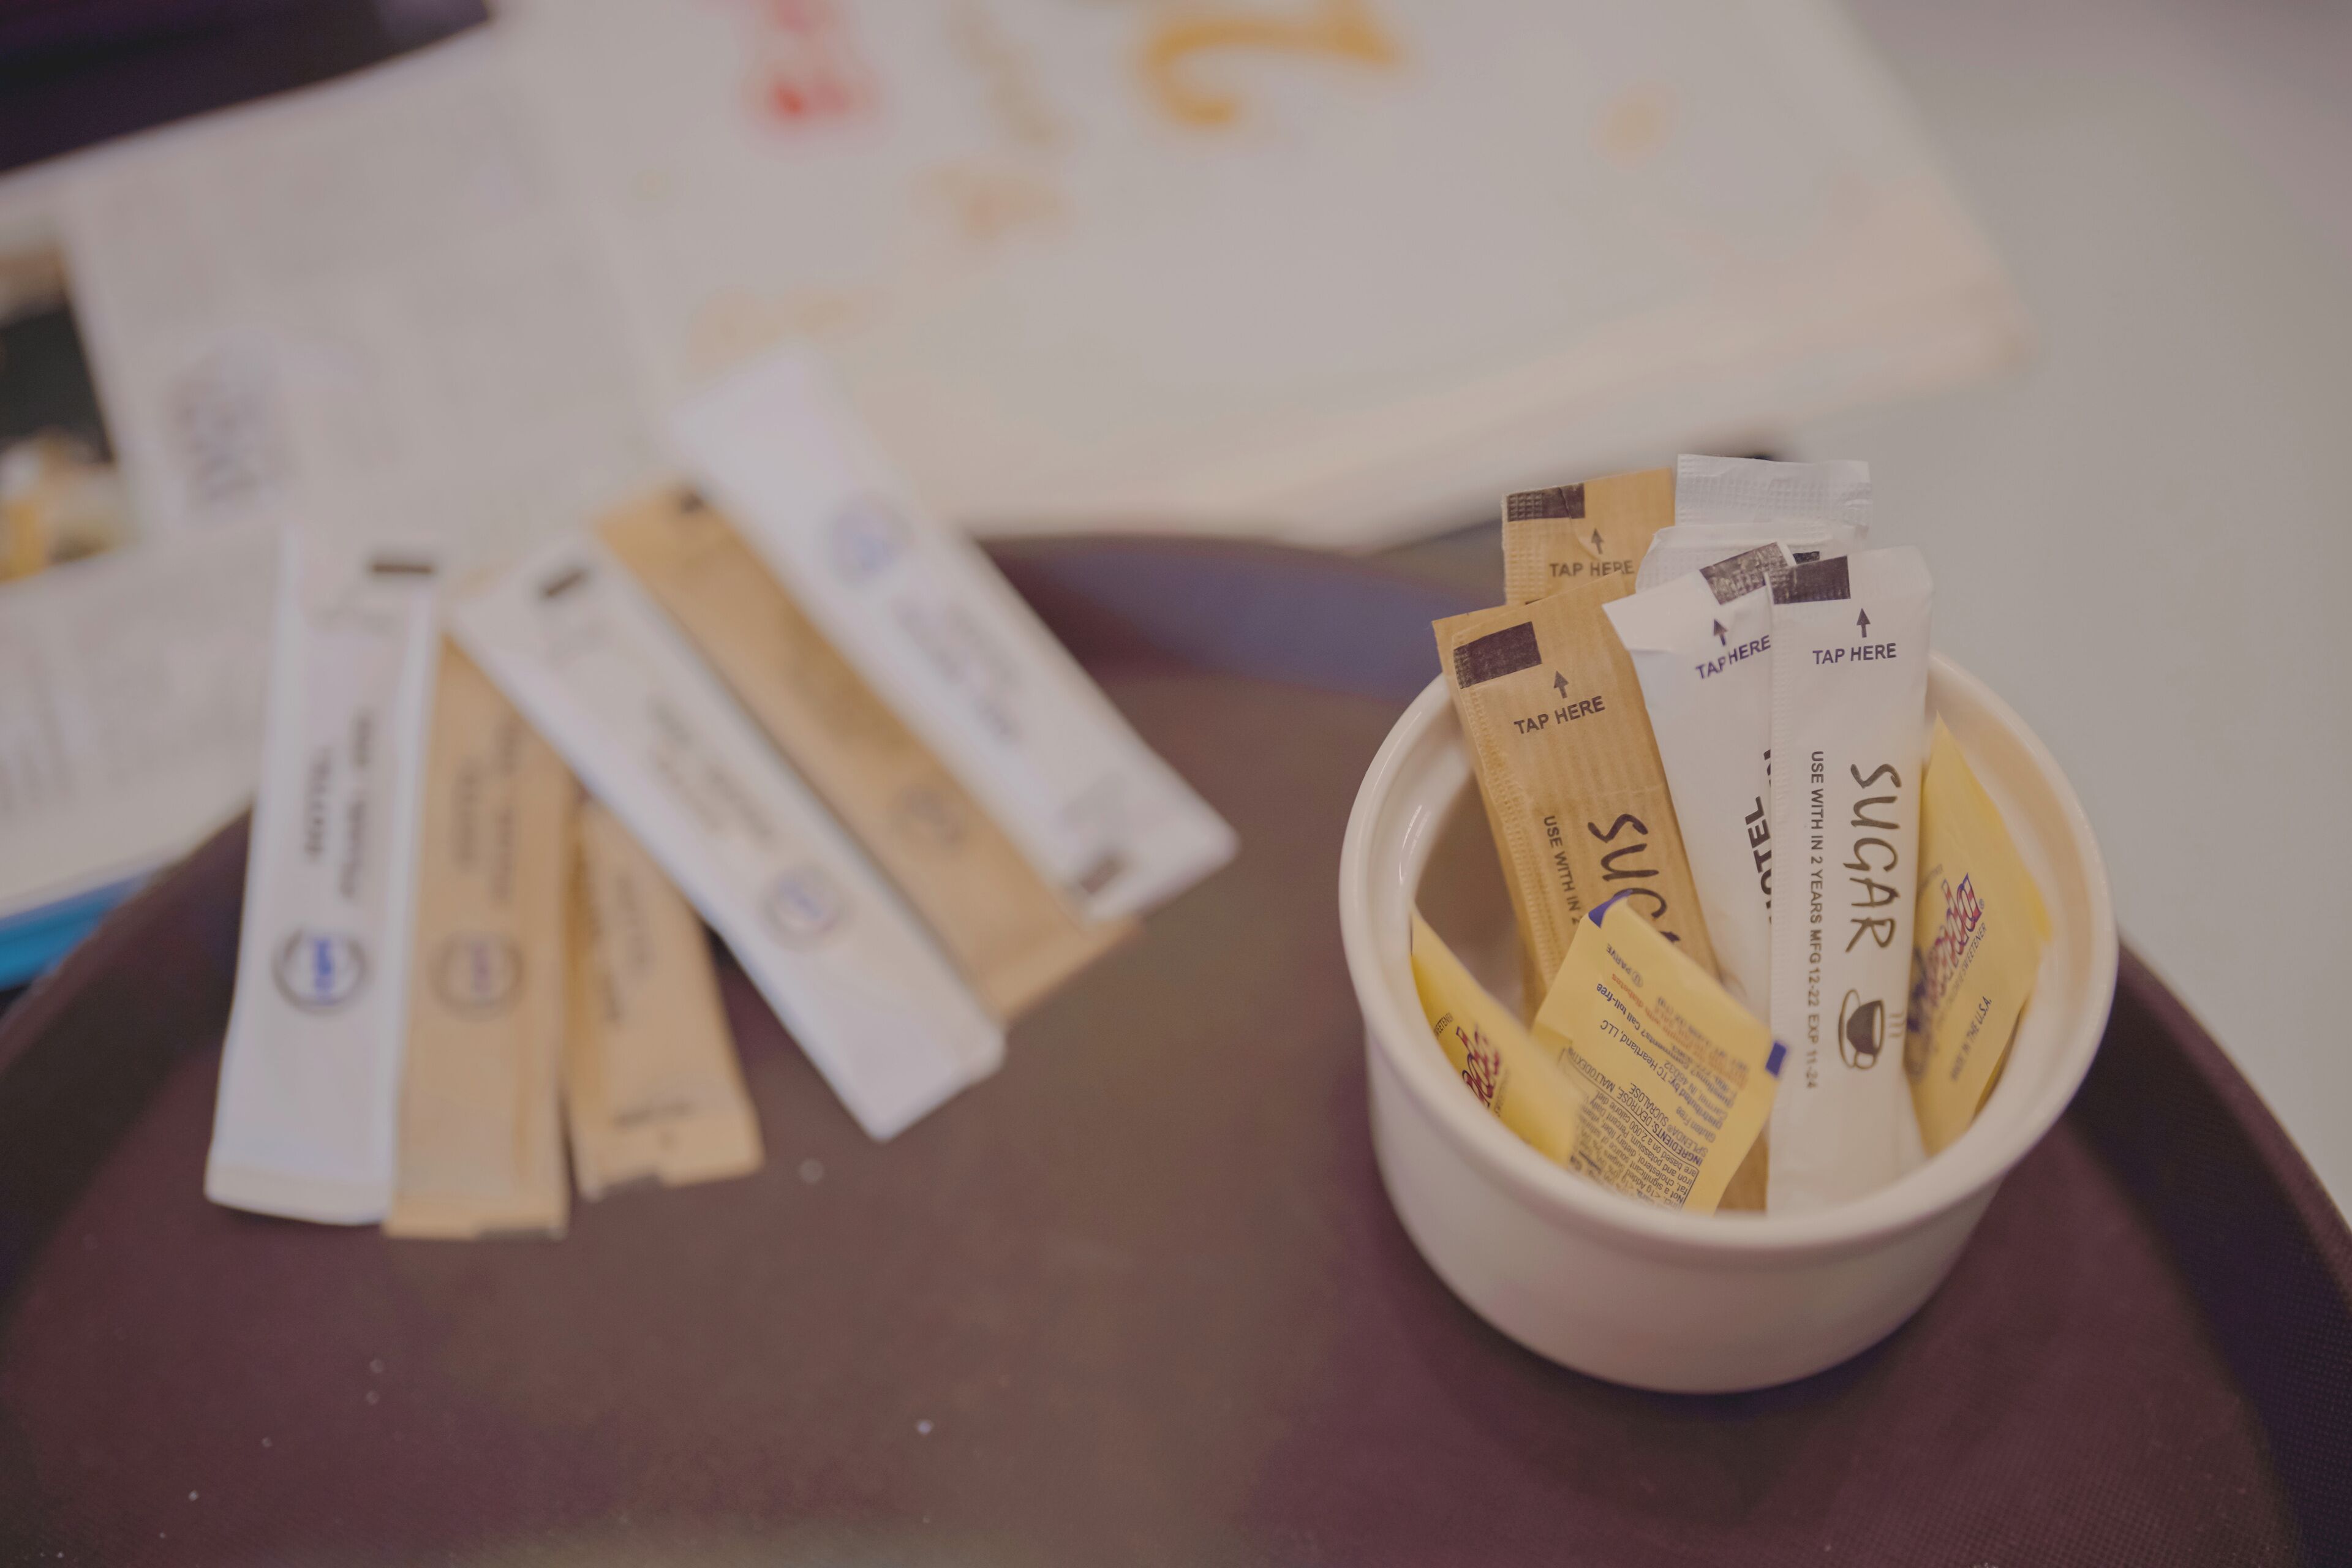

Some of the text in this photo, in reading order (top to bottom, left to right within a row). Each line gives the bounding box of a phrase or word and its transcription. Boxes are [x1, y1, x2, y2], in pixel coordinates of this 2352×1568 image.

[1549, 560, 1635, 578] TAP HERE
[1695, 635, 1771, 679] TAP HERE
[1812, 643, 1897, 665] TAP HERE
[1513, 695, 1605, 734] TAP HERE
[1811, 751, 1824, 783] USE
[1811, 788, 1824, 829] WITH
[1811, 835, 1823, 850] IN
[1544, 815, 1562, 848] USE
[1554, 851, 1575, 892] WITH
[1566, 895, 1581, 911] IN
[1842, 764, 1902, 952] SUGAR
[1810, 869, 1823, 924] YEARS
[1605, 944, 1631, 974] PARVE
[1809, 929, 1822, 963] MFG
[1597, 984, 1626, 1014] toll-free
[1612, 974, 1643, 1007] diabetes
[1808, 967, 1821, 1007] 12-22
[1627, 1012, 1640, 1030] Call
[1975, 995, 1992, 1025] U.S.A.
[1600, 1020, 1618, 1037] LLC
[1807, 1014, 1820, 1043] EXP
[1620, 1031, 1657, 1069] Heartland,
[1657, 1066, 1667, 1081] TC
[1610, 1102, 1630, 1123] calorie
[1617, 1087, 1652, 1126] DEXTROSE,
[1629, 1083, 1668, 1126] SUCRALOSE.
[1606, 1113, 1629, 1137] Percent
[1629, 1121, 1647, 1141] 2,000
[1676, 1106, 1716, 1142] Gluten Free
[1609, 1145, 1629, 1163] source
[1616, 1134, 1636, 1156] dietary
[1630, 1134, 1662, 1166] potassium.
[1652, 1121, 1702, 1165] INGREDIENTS:
[1653, 1143, 1661, 1153] on
[1629, 1161, 1662, 1189] significant
[1638, 1154, 1674, 1186] cholesterol,
[1661, 1152, 1683, 1170] based
[1662, 1164, 1676, 1176] and
[1684, 1166, 1696, 1177] are
[1624, 1169, 1645, 1188] Added
[1677, 1174, 1692, 1185] iron
[1677, 1182, 1687, 1195] fat,
[1670, 1191, 1684, 1203] Not
